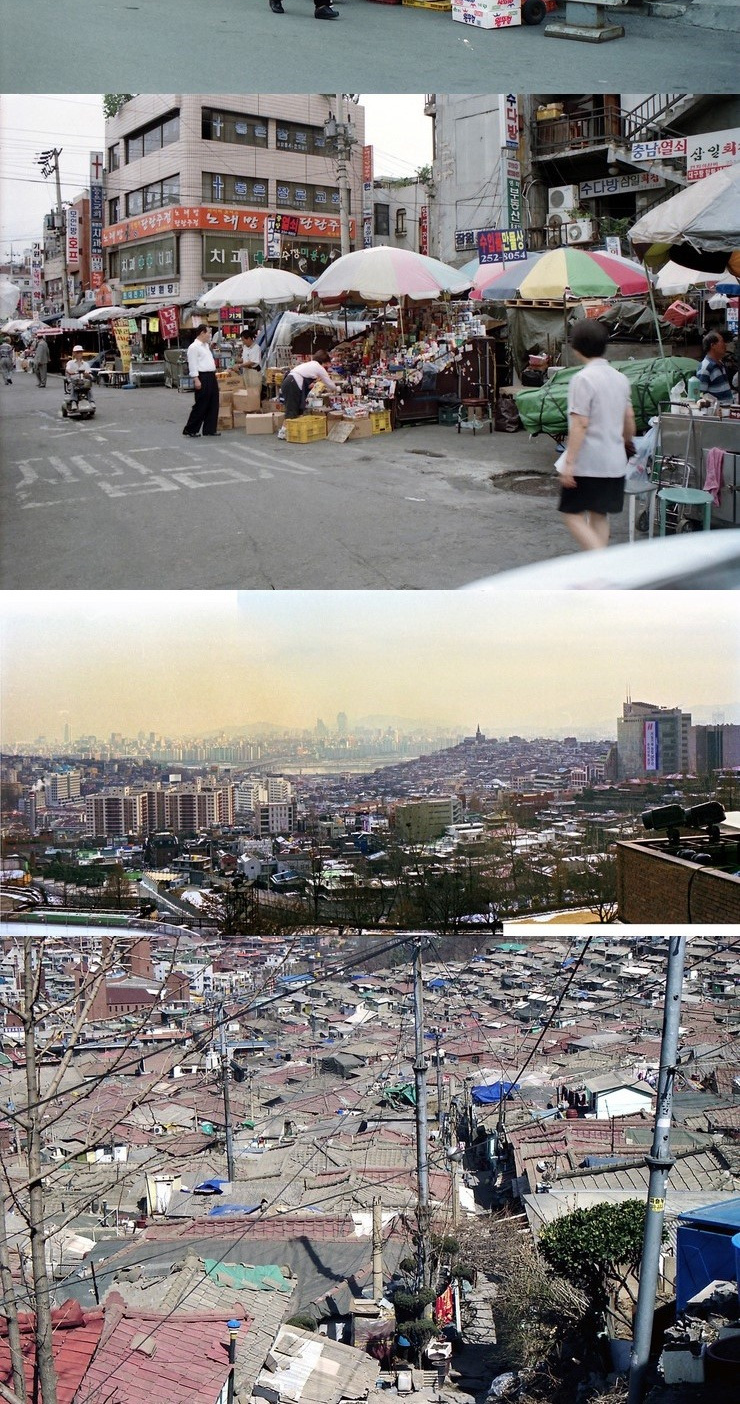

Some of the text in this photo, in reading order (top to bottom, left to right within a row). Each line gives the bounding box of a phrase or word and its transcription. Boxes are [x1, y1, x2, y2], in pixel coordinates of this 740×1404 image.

[660, 138, 687, 156] 열쇠
[721, 141, 740, 157] 회
[580, 179, 619, 196] 수다방
[206, 212, 353, 234] 노래방 단란주
[69, 236, 79, 263] 호프
[480, 250, 527, 264] 252-8054
